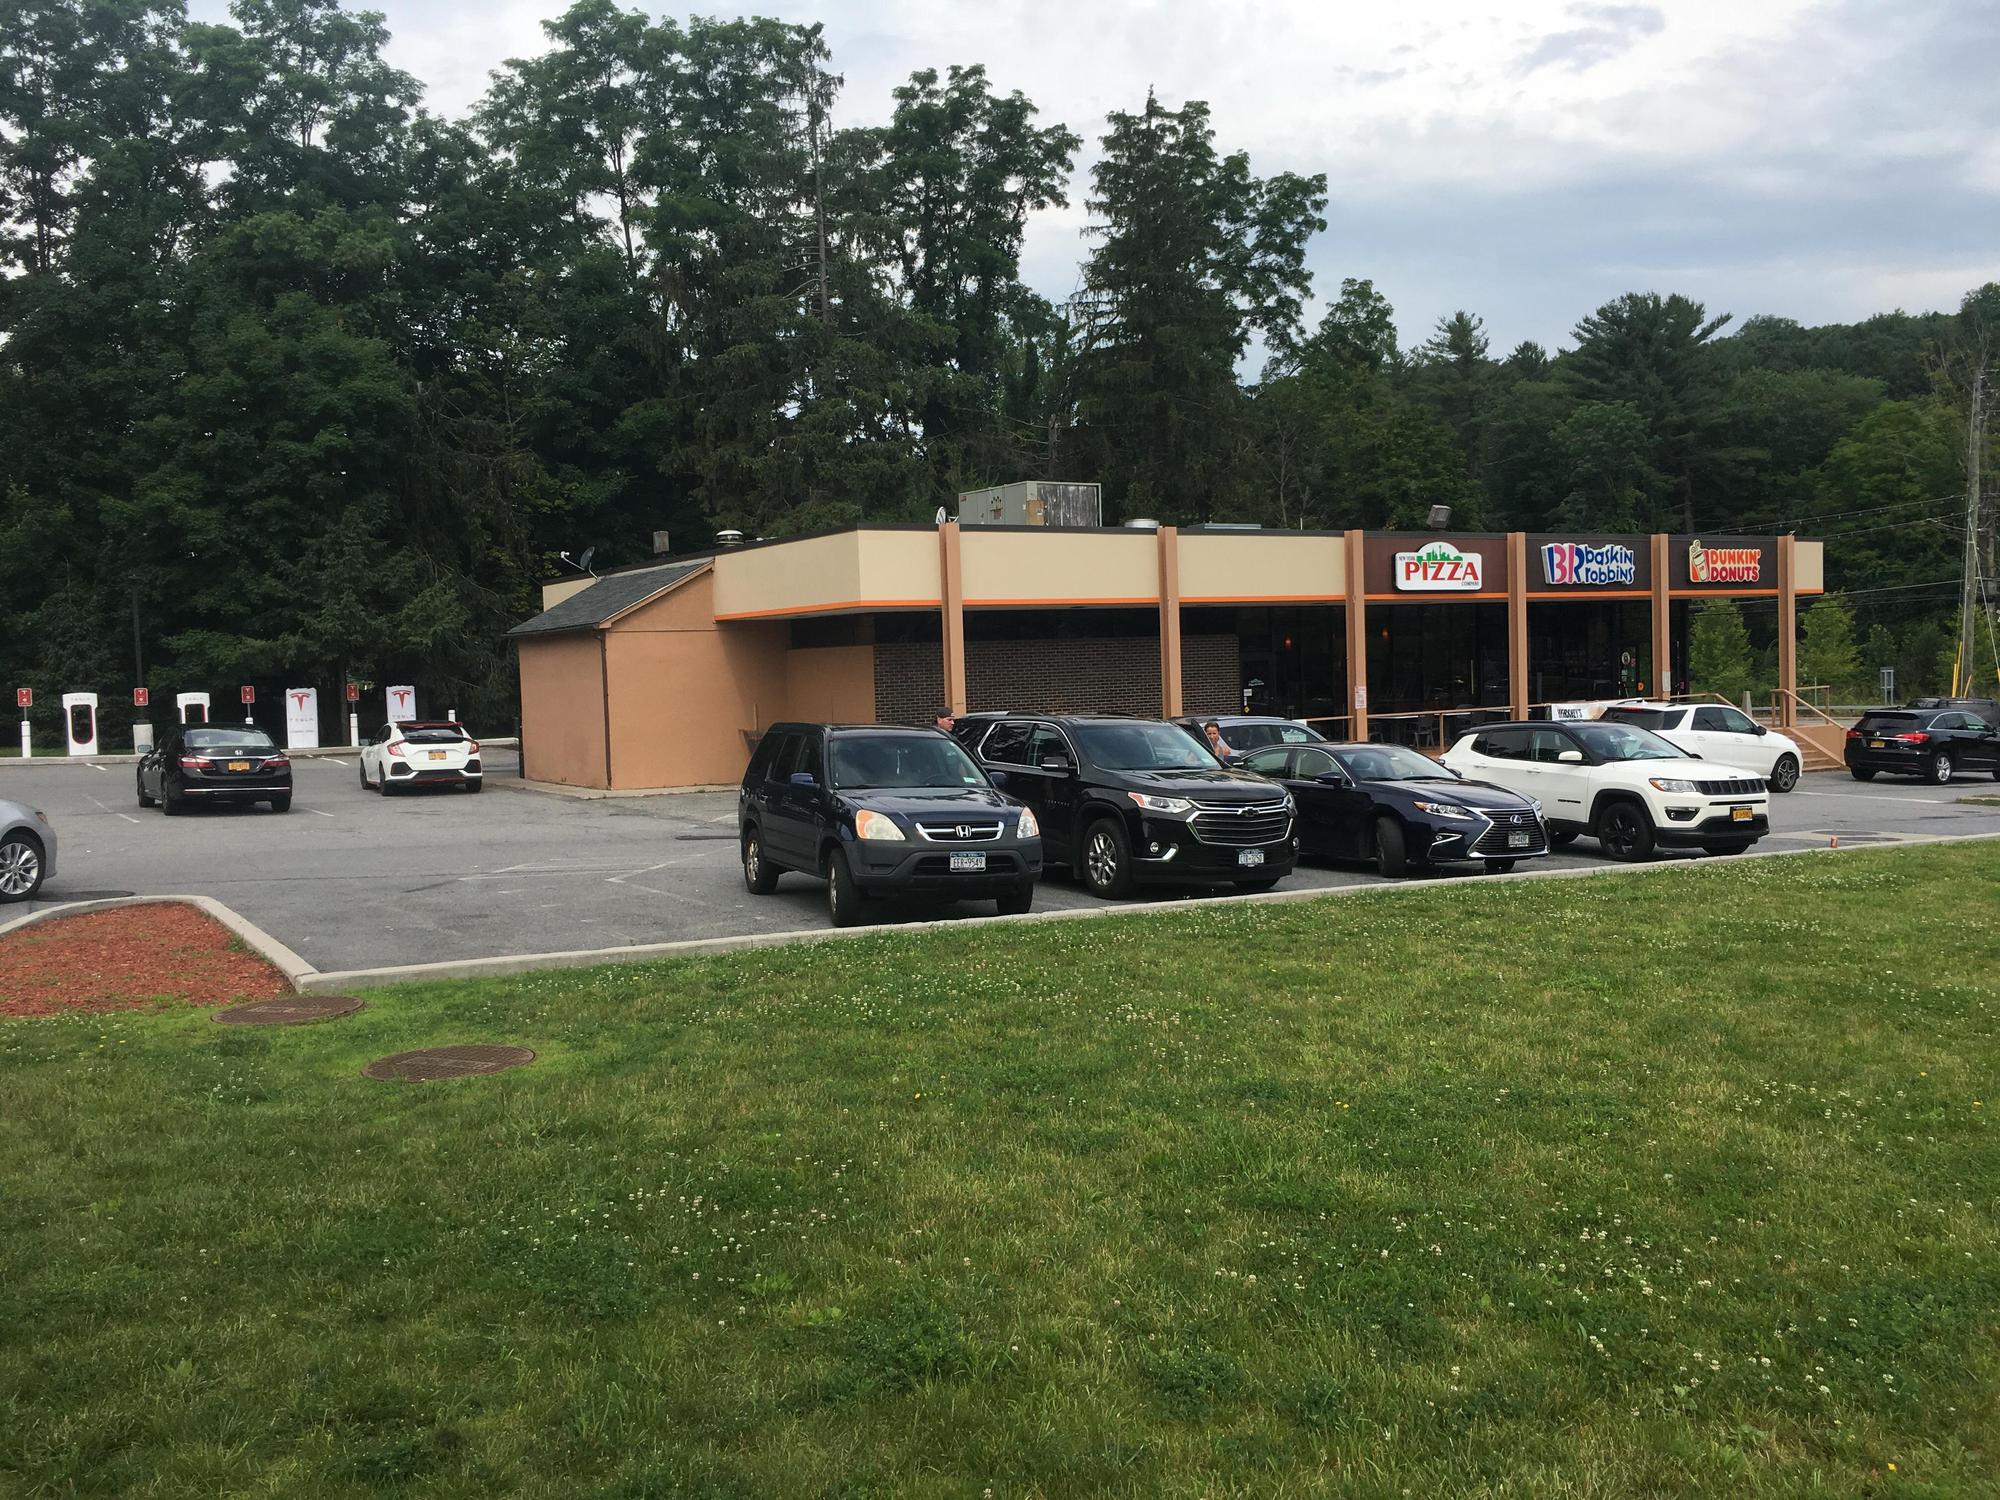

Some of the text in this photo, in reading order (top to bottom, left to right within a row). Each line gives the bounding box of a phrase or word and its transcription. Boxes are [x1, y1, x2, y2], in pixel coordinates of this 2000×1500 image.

[1710, 550, 1760, 565] DUNKIN'
[1405, 562, 1479, 580] PIZZA
[1710, 566, 1759, 581] DONUTS
